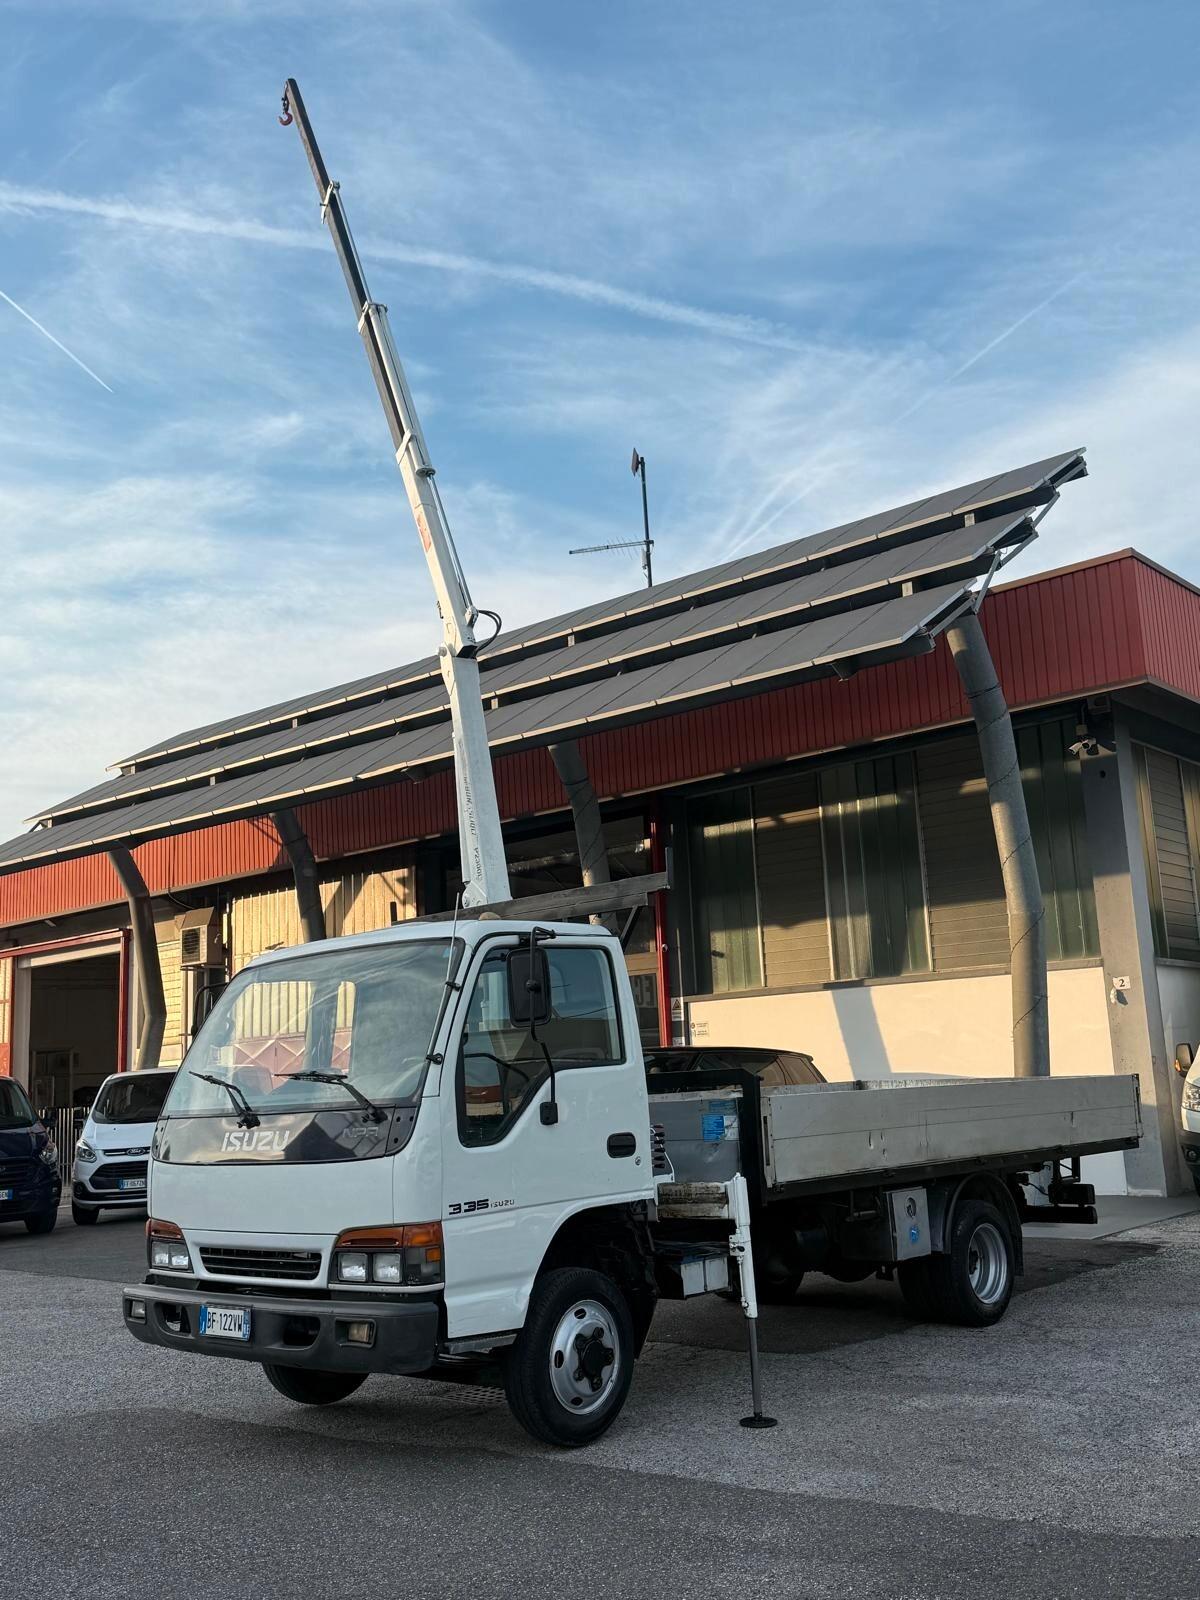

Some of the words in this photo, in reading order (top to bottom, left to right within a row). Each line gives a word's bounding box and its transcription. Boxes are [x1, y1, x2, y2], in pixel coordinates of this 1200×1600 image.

[1119, 979, 1125, 987] 2
[221, 1130, 290, 1152] ISUZU
[207, 1311, 217, 1329] BF
